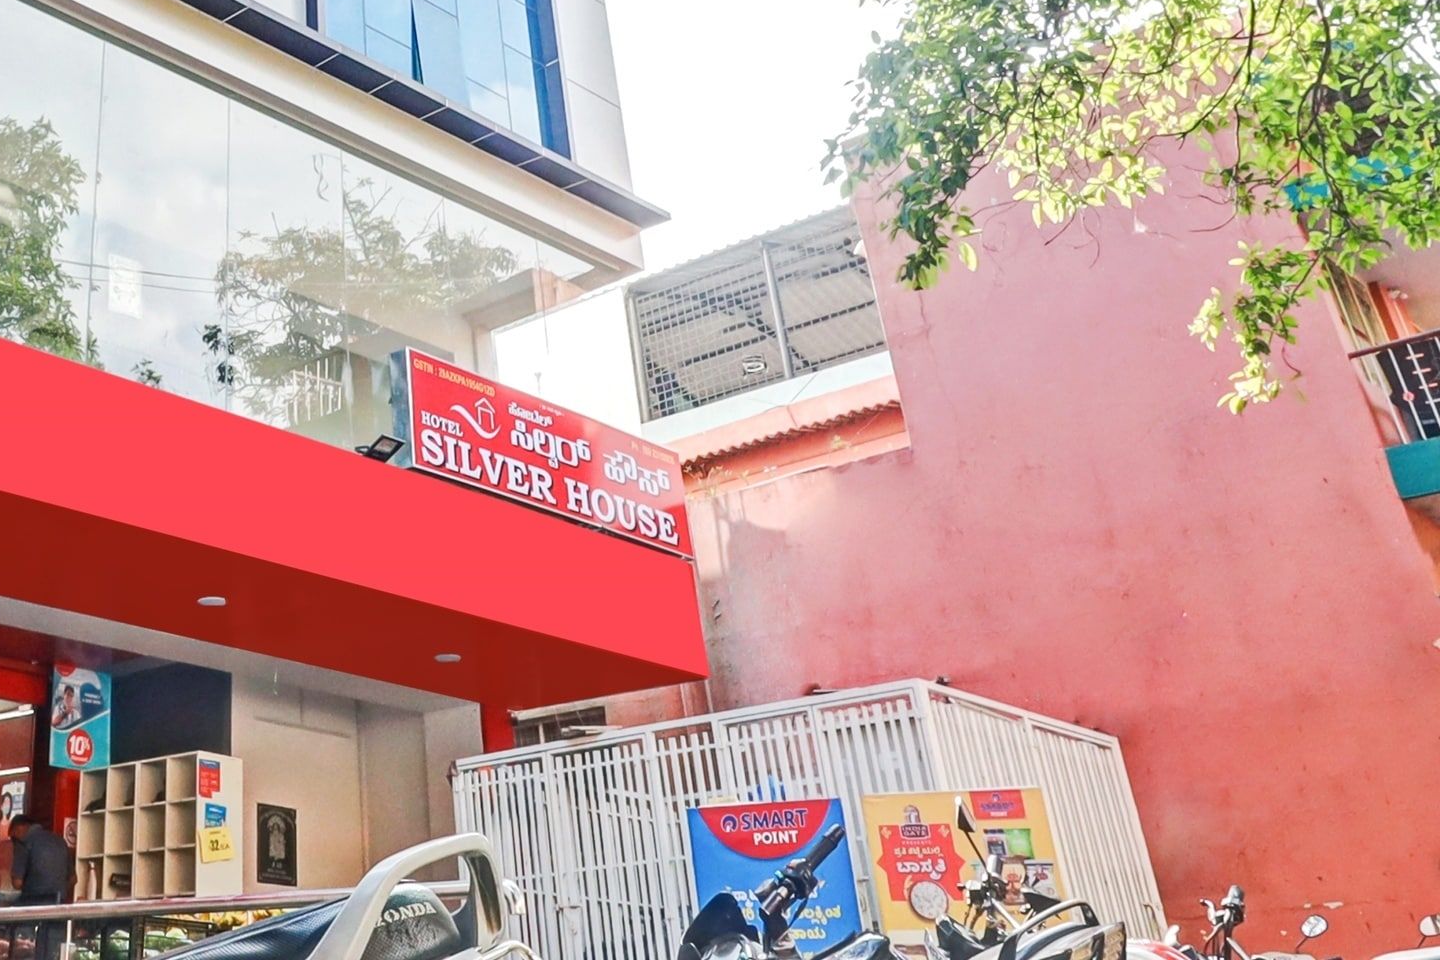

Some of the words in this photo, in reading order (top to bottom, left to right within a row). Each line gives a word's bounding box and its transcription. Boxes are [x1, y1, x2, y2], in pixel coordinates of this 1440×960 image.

[420, 410, 463, 437] HOTEL
[420, 429, 557, 505] SILVER
[564, 477, 679, 546] HOUSE
[740, 808, 808, 831] SMART
[753, 830, 798, 845] POINT
